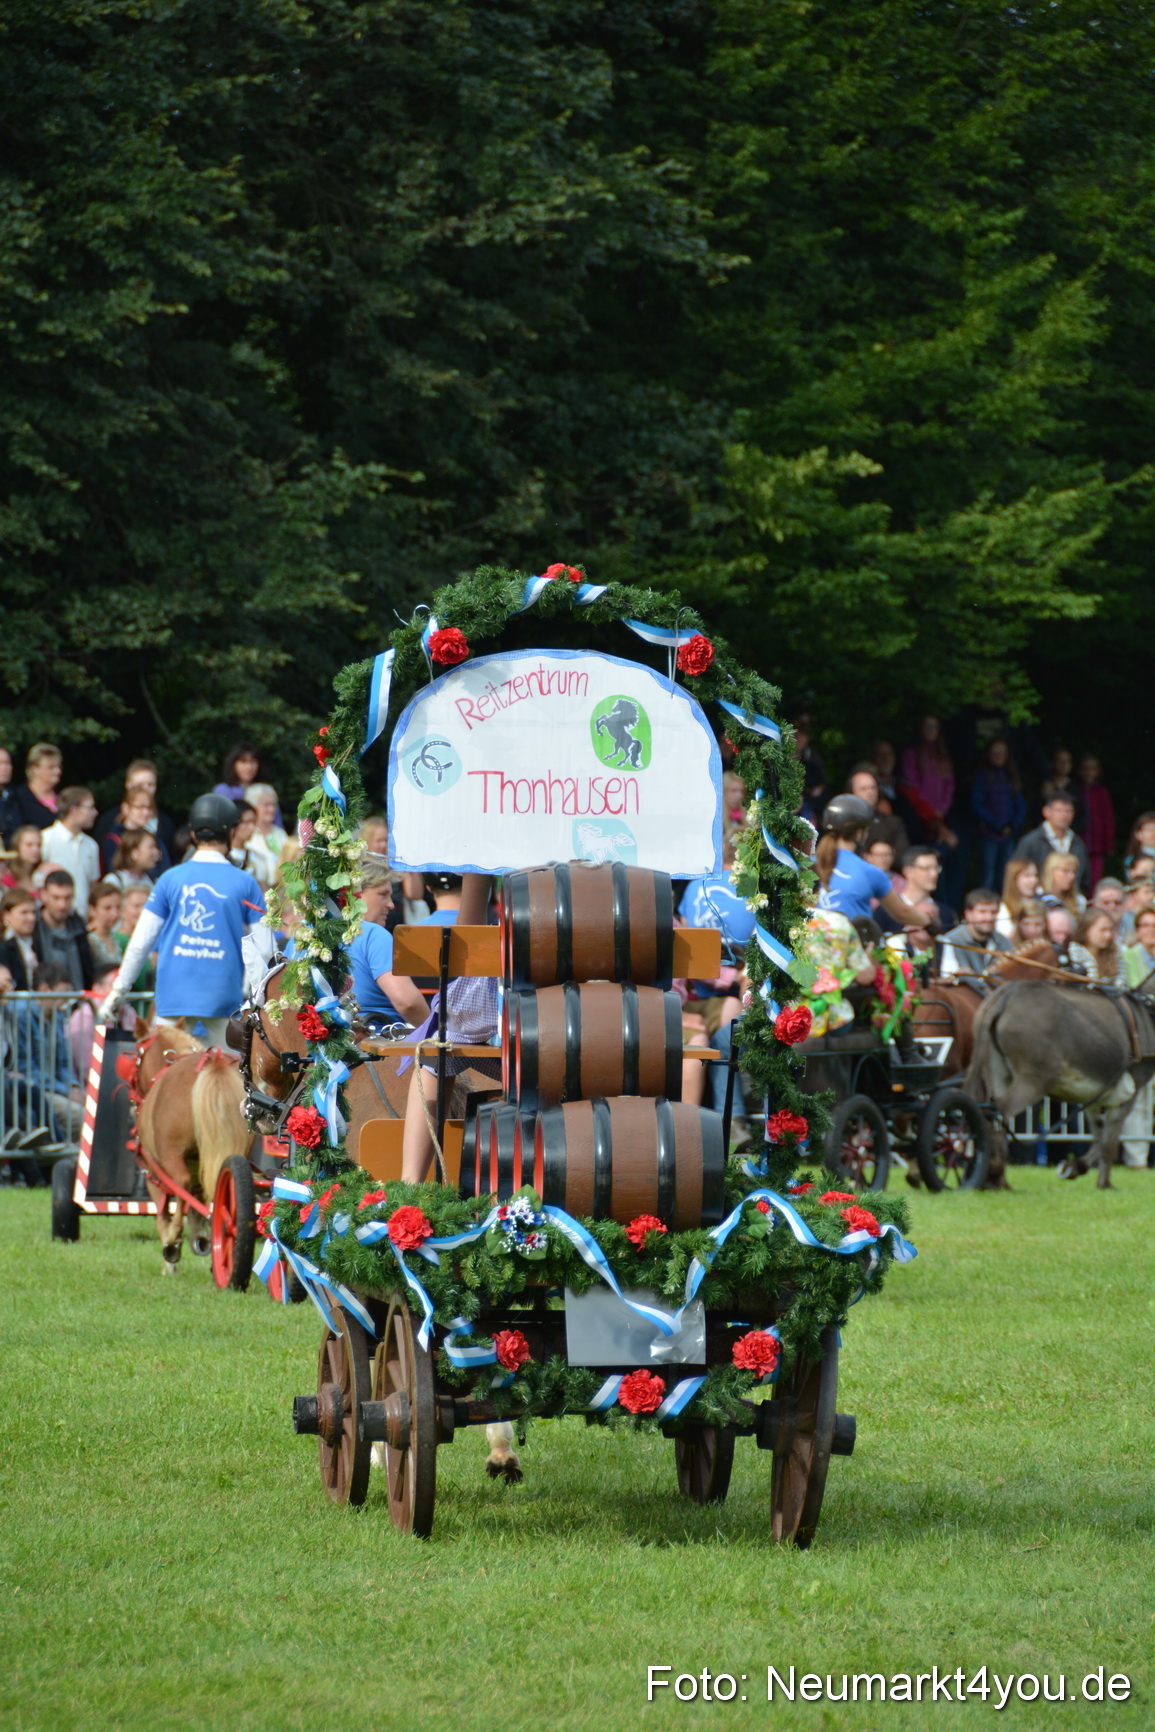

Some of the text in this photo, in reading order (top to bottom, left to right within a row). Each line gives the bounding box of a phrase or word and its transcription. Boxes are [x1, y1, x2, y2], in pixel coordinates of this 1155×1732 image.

[454, 662, 589, 730] Reitzentrum
[467, 769, 640, 815] Thonhausen
[174, 946, 225, 959] Ponyhof
